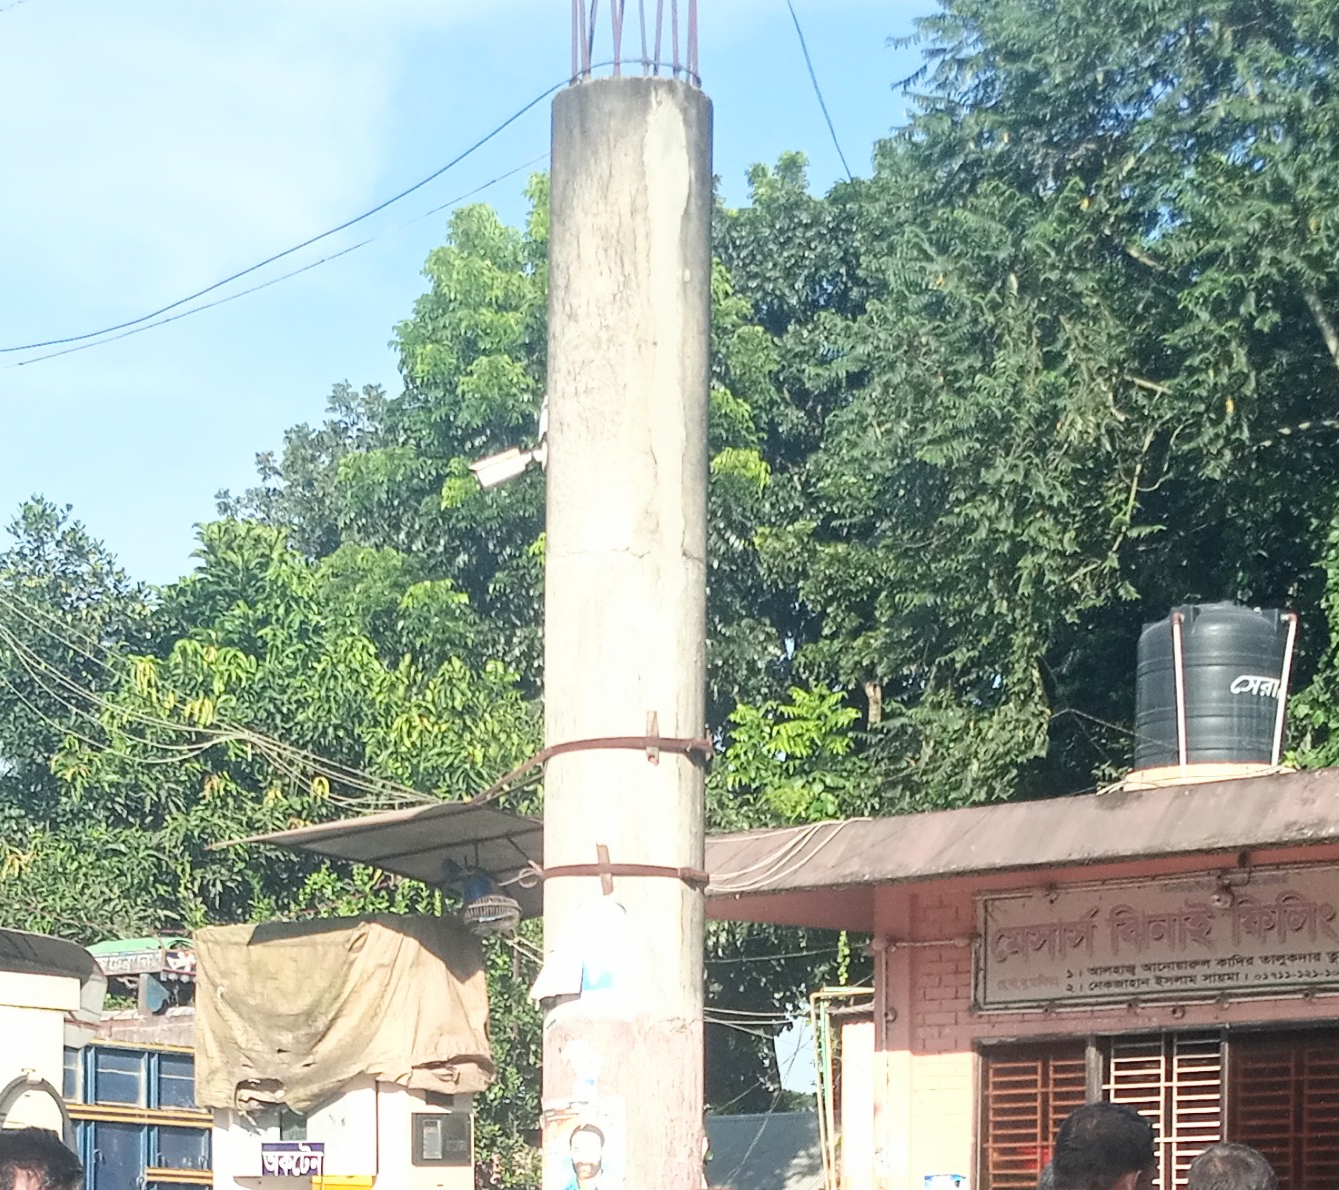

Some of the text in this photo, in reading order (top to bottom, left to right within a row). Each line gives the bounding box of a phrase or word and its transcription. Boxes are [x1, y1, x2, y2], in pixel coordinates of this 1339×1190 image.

[990, 908, 1097, 962] মেসার্স
[1110, 903, 1220, 956] ঝিনাই
[262, 1142, 324, 1177] অকটেন
